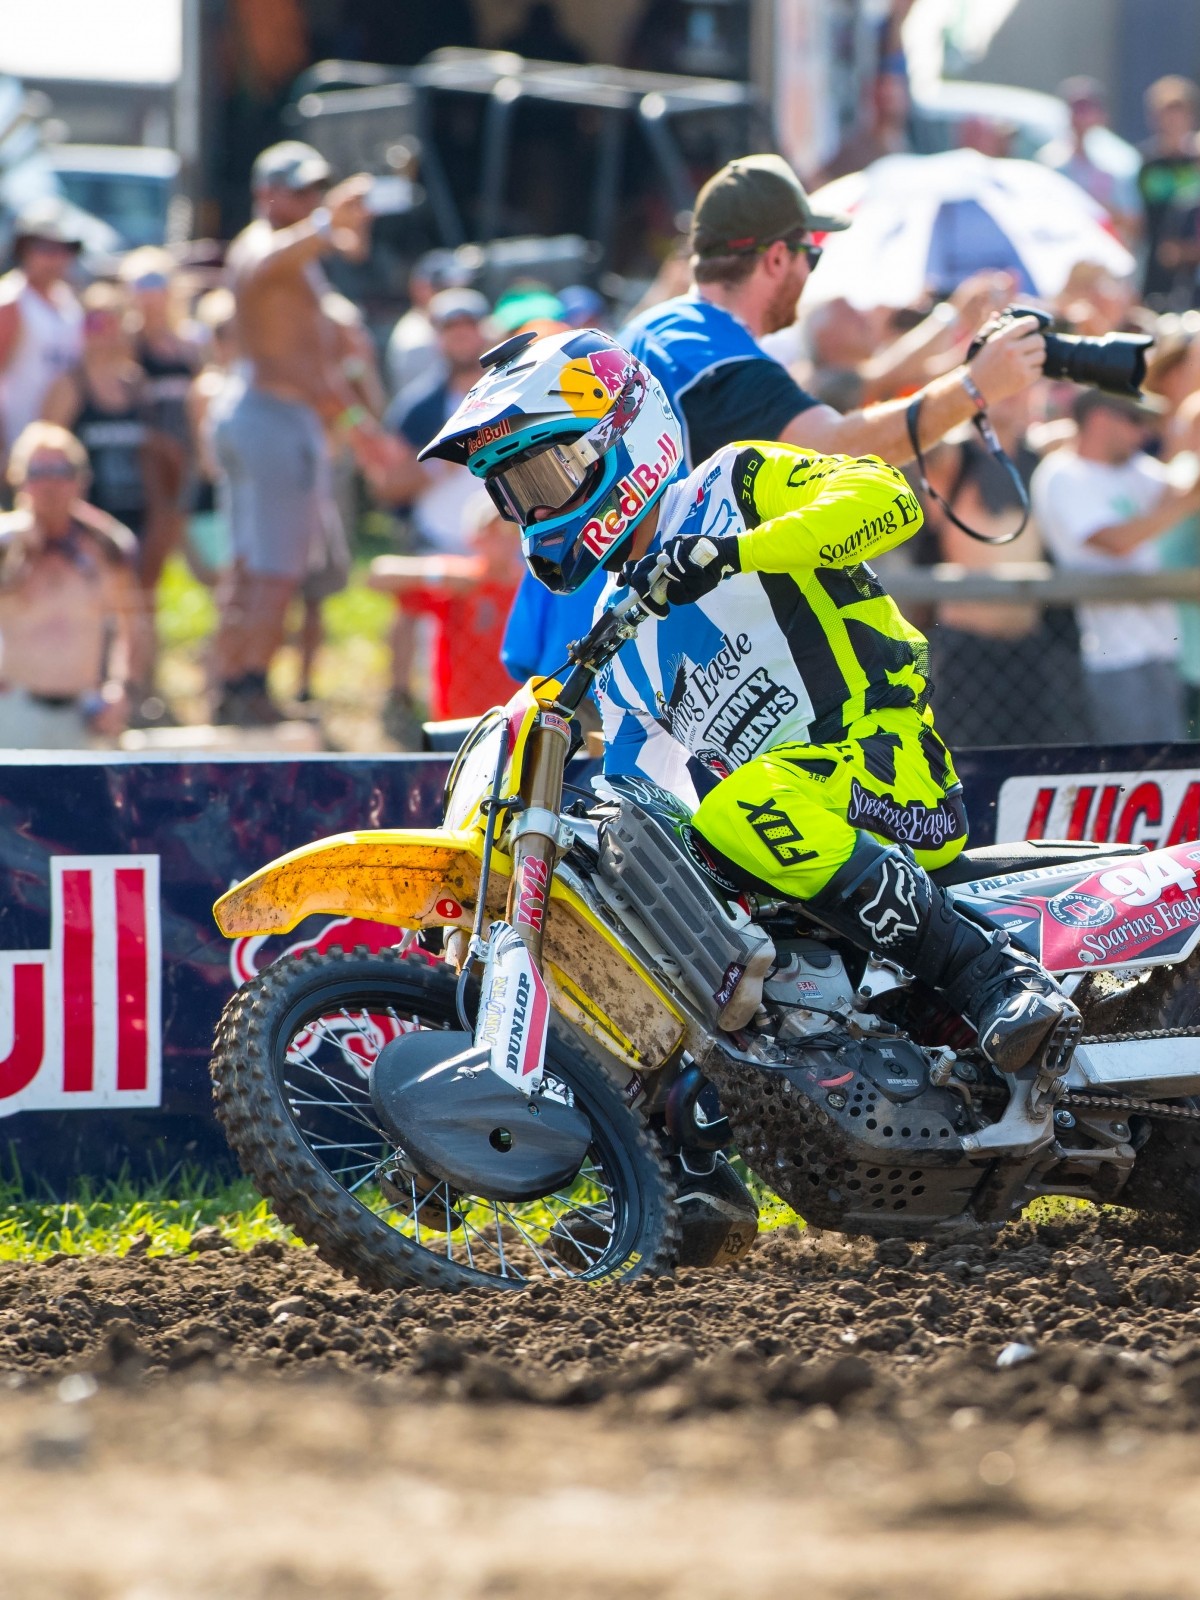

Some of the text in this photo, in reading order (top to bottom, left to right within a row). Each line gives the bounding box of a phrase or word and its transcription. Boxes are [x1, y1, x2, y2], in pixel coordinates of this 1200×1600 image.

[742, 459, 759, 505] 360
[819, 509, 898, 567] Soaring
[598, 660, 614, 693] SUZ
[689, 631, 753, 710] Eagle
[703, 668, 772, 753] JIMMY
[808, 771, 828, 784] 360
[736, 797, 820, 867] FOX
[905, 804, 957, 845] Eagle
[517, 855, 549, 934] KYB
[967, 868, 1042, 895] FREAKY
[1098, 850, 1199, 907] 94
[1082, 912, 1165, 960] Soaring
[506, 971, 531, 1075] DUNLOP
[587, 1250, 643, 1290] DUNLO
